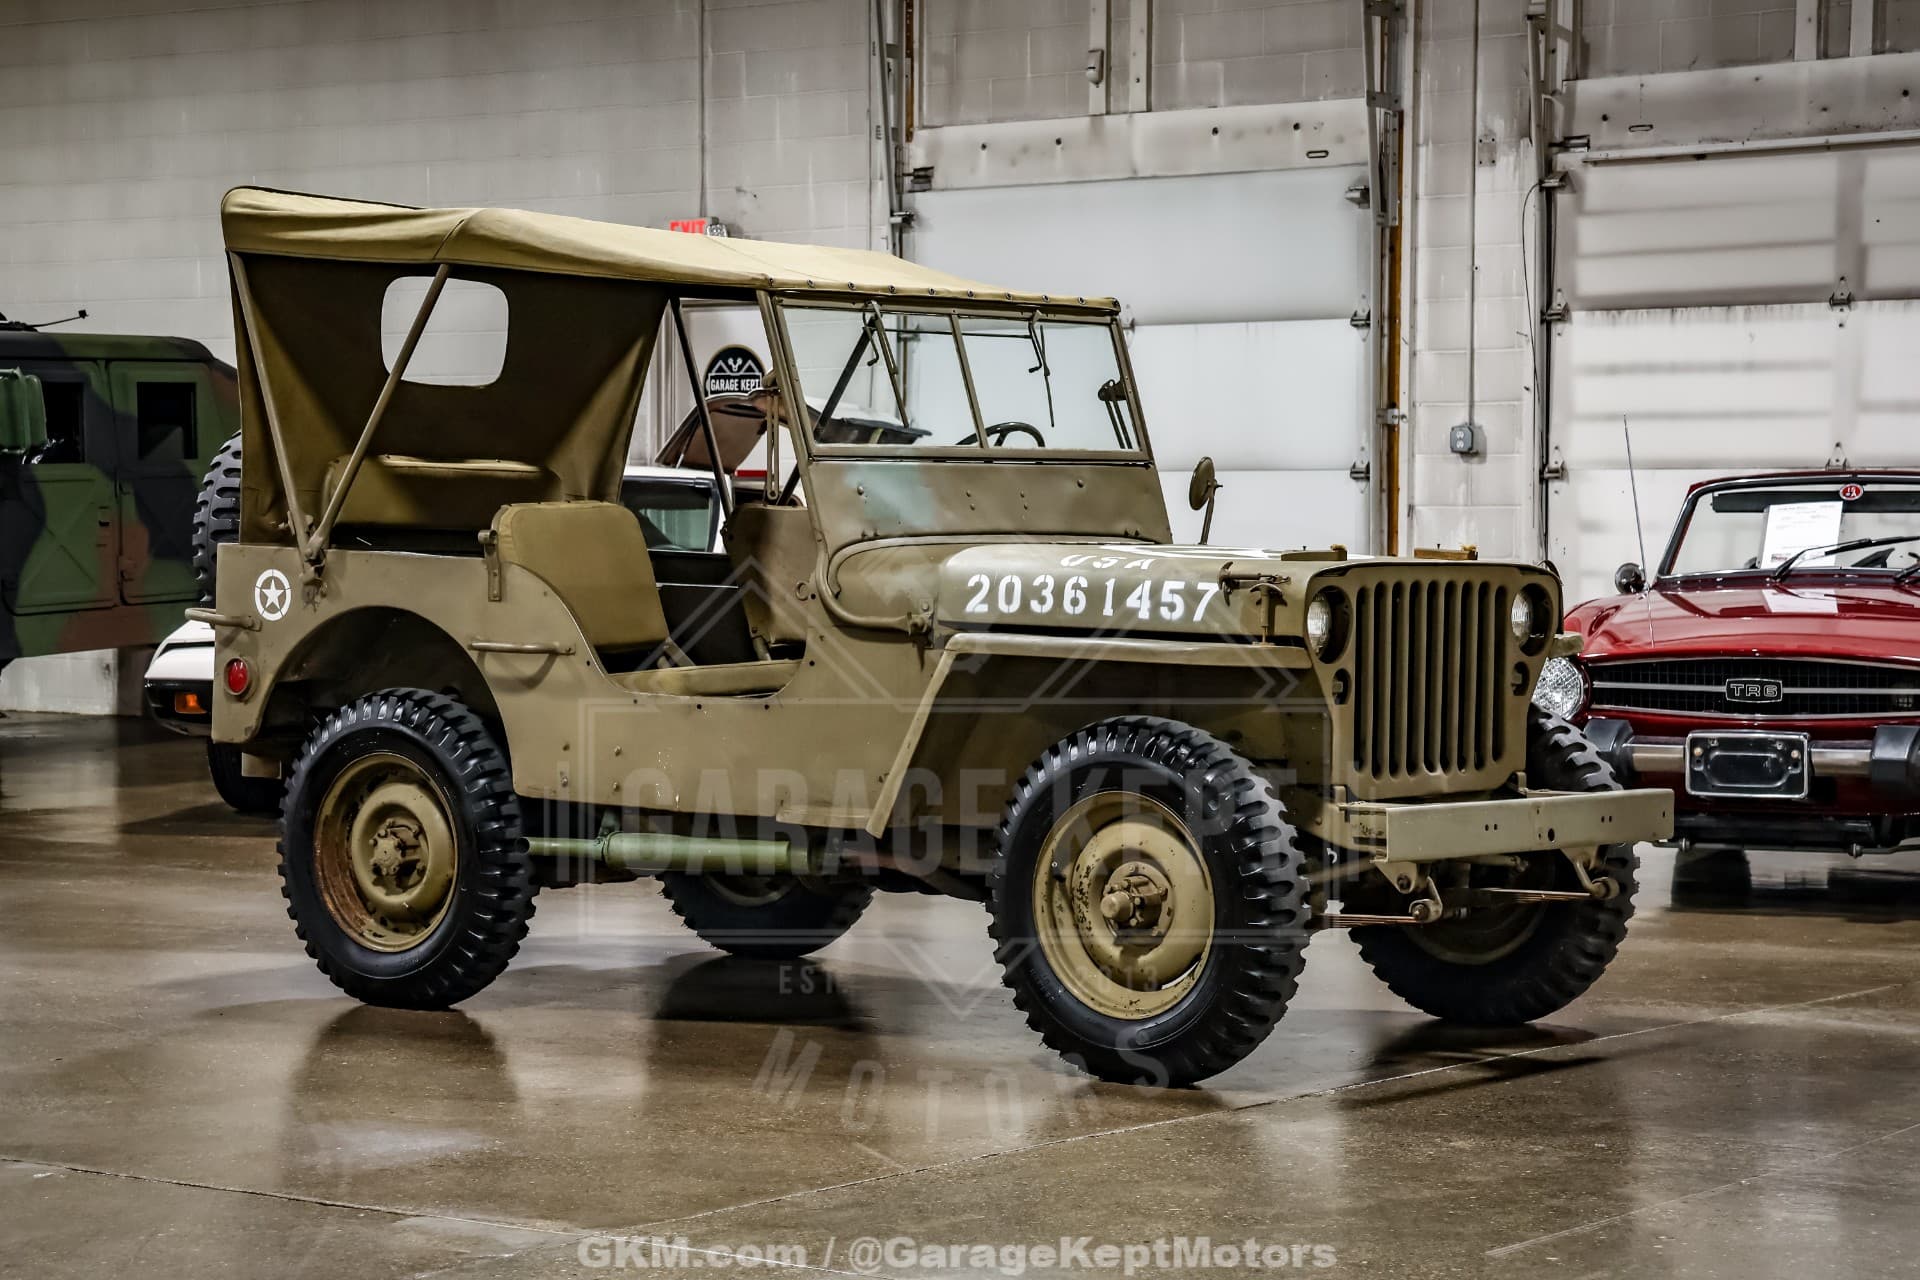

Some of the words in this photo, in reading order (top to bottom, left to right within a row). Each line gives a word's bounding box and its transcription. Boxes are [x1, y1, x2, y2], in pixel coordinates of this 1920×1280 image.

[710, 378, 740, 391] GARAGE
[741, 378, 760, 391] KEPT
[1060, 554, 1156, 570] USA
[965, 574, 1219, 622] 20361457
[1730, 683, 1778, 698] TR6
